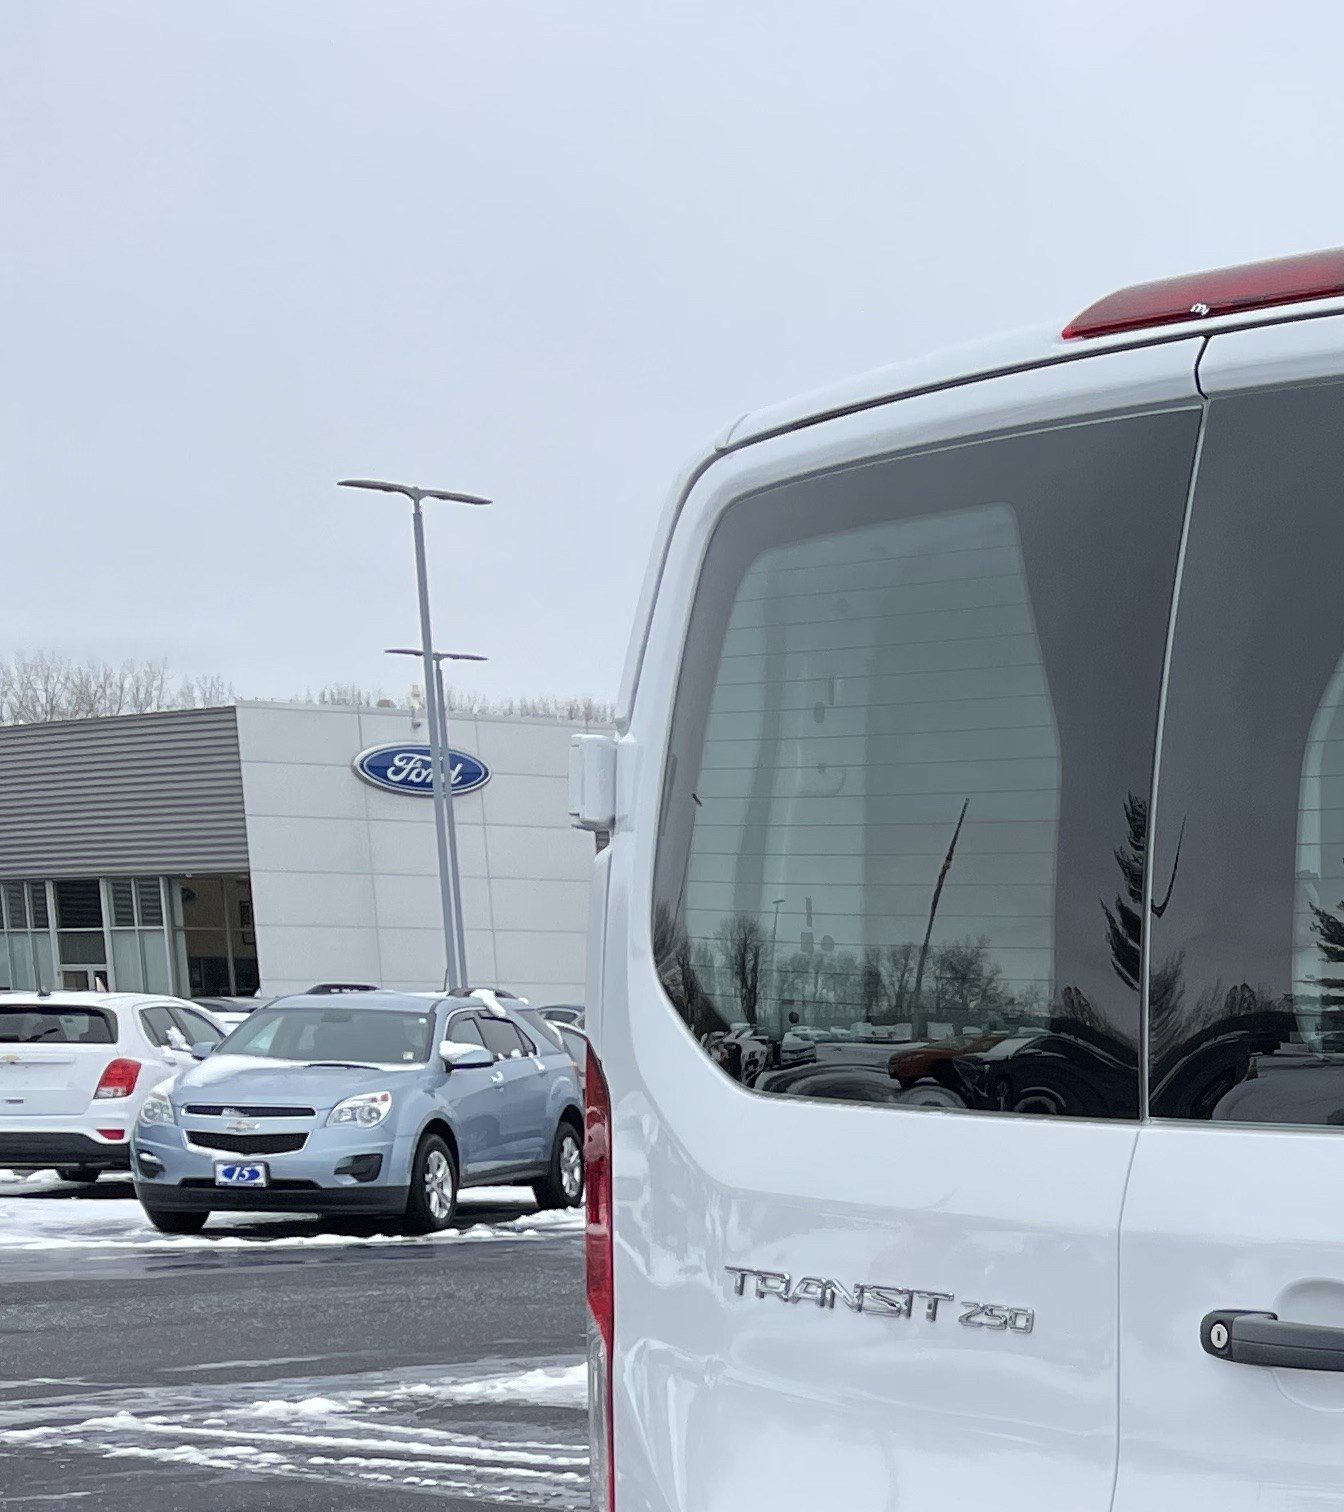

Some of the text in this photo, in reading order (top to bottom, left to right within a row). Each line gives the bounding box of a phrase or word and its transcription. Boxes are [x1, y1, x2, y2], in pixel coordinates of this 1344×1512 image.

[231, 1166, 252, 1181] 15
[724, 1265, 1035, 1334] TRANSIT 250
